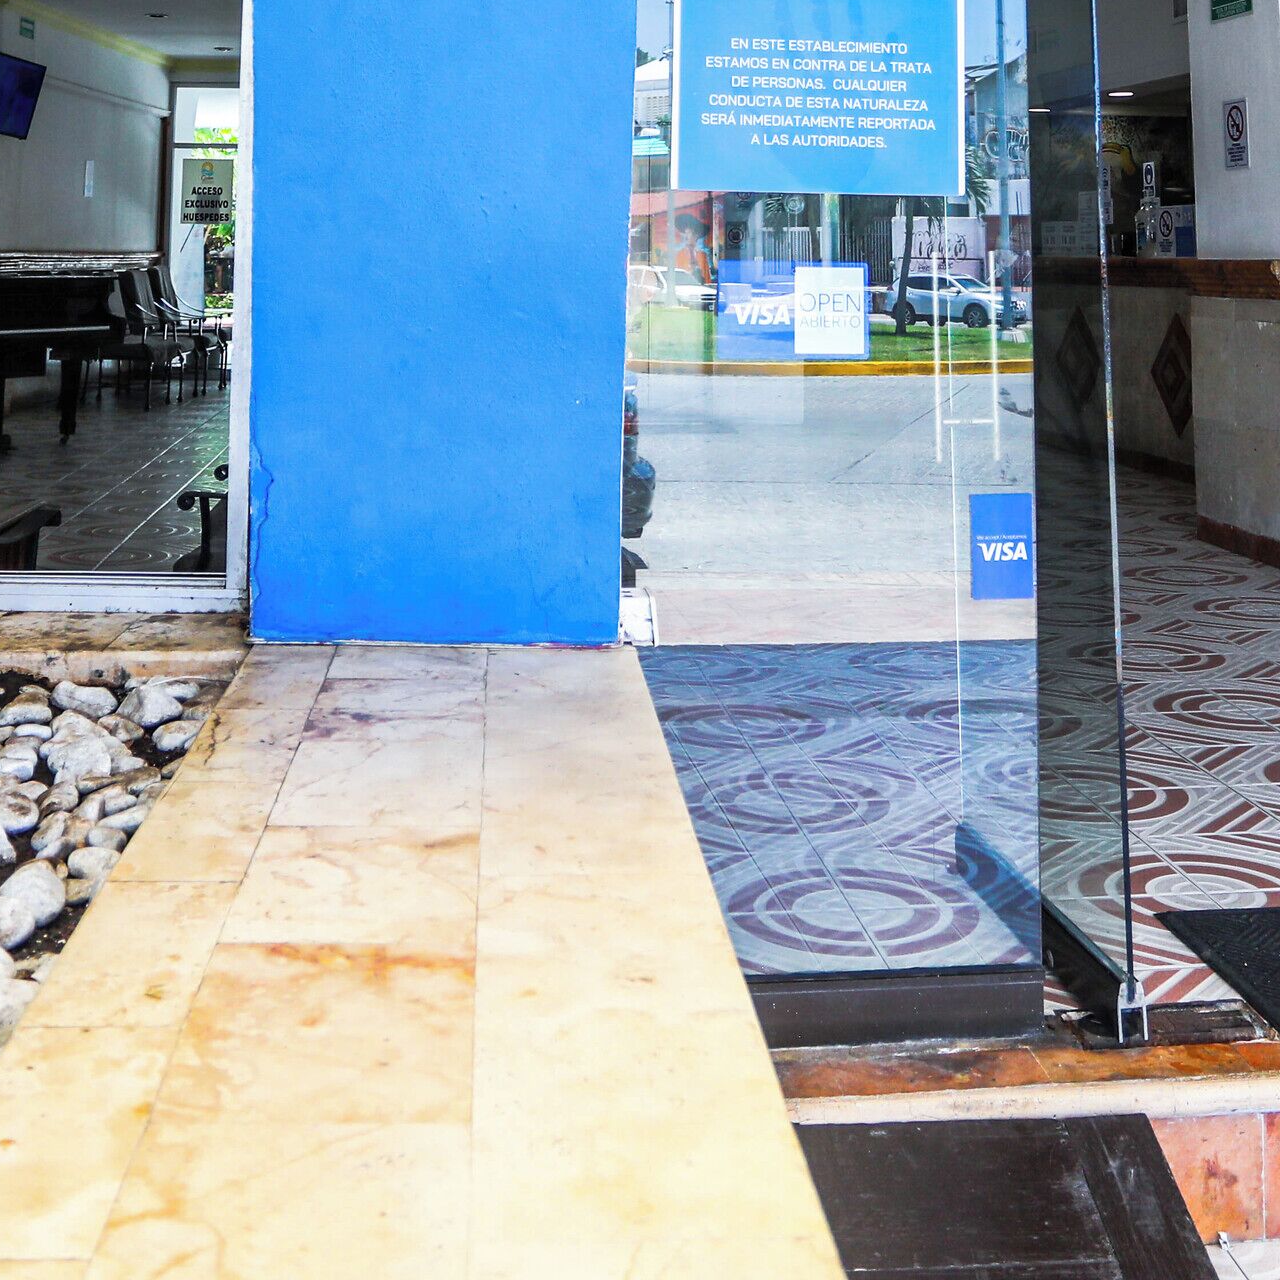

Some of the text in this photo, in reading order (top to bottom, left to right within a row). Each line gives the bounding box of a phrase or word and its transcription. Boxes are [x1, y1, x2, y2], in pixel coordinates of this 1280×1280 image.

[731, 38, 908, 54] EN ESTE ESTABLECIMIENTO
[706, 56, 932, 74] ESTAMOS EN CONTRA DE LA TRATA
[732, 76, 906, 92] DE PERSONAS. CUALQUIER
[709, 94, 928, 112] CONDUCTA DE ESTA NATURALEZA
[701, 111, 936, 130] SERÁ INMEDIATAMENTE REPORTADA
[751, 134, 888, 148] A LAS AUTORIDADES.
[191, 186, 223, 196] ACCESO
[184, 200, 229, 208] EXCLUSIVO
[183, 212, 230, 222] HUESPEDES
[799, 292, 861, 312] OPEN
[734, 304, 791, 325] VISA
[800, 315, 861, 328] ABIERTO
[977, 542, 1028, 562] VISA
